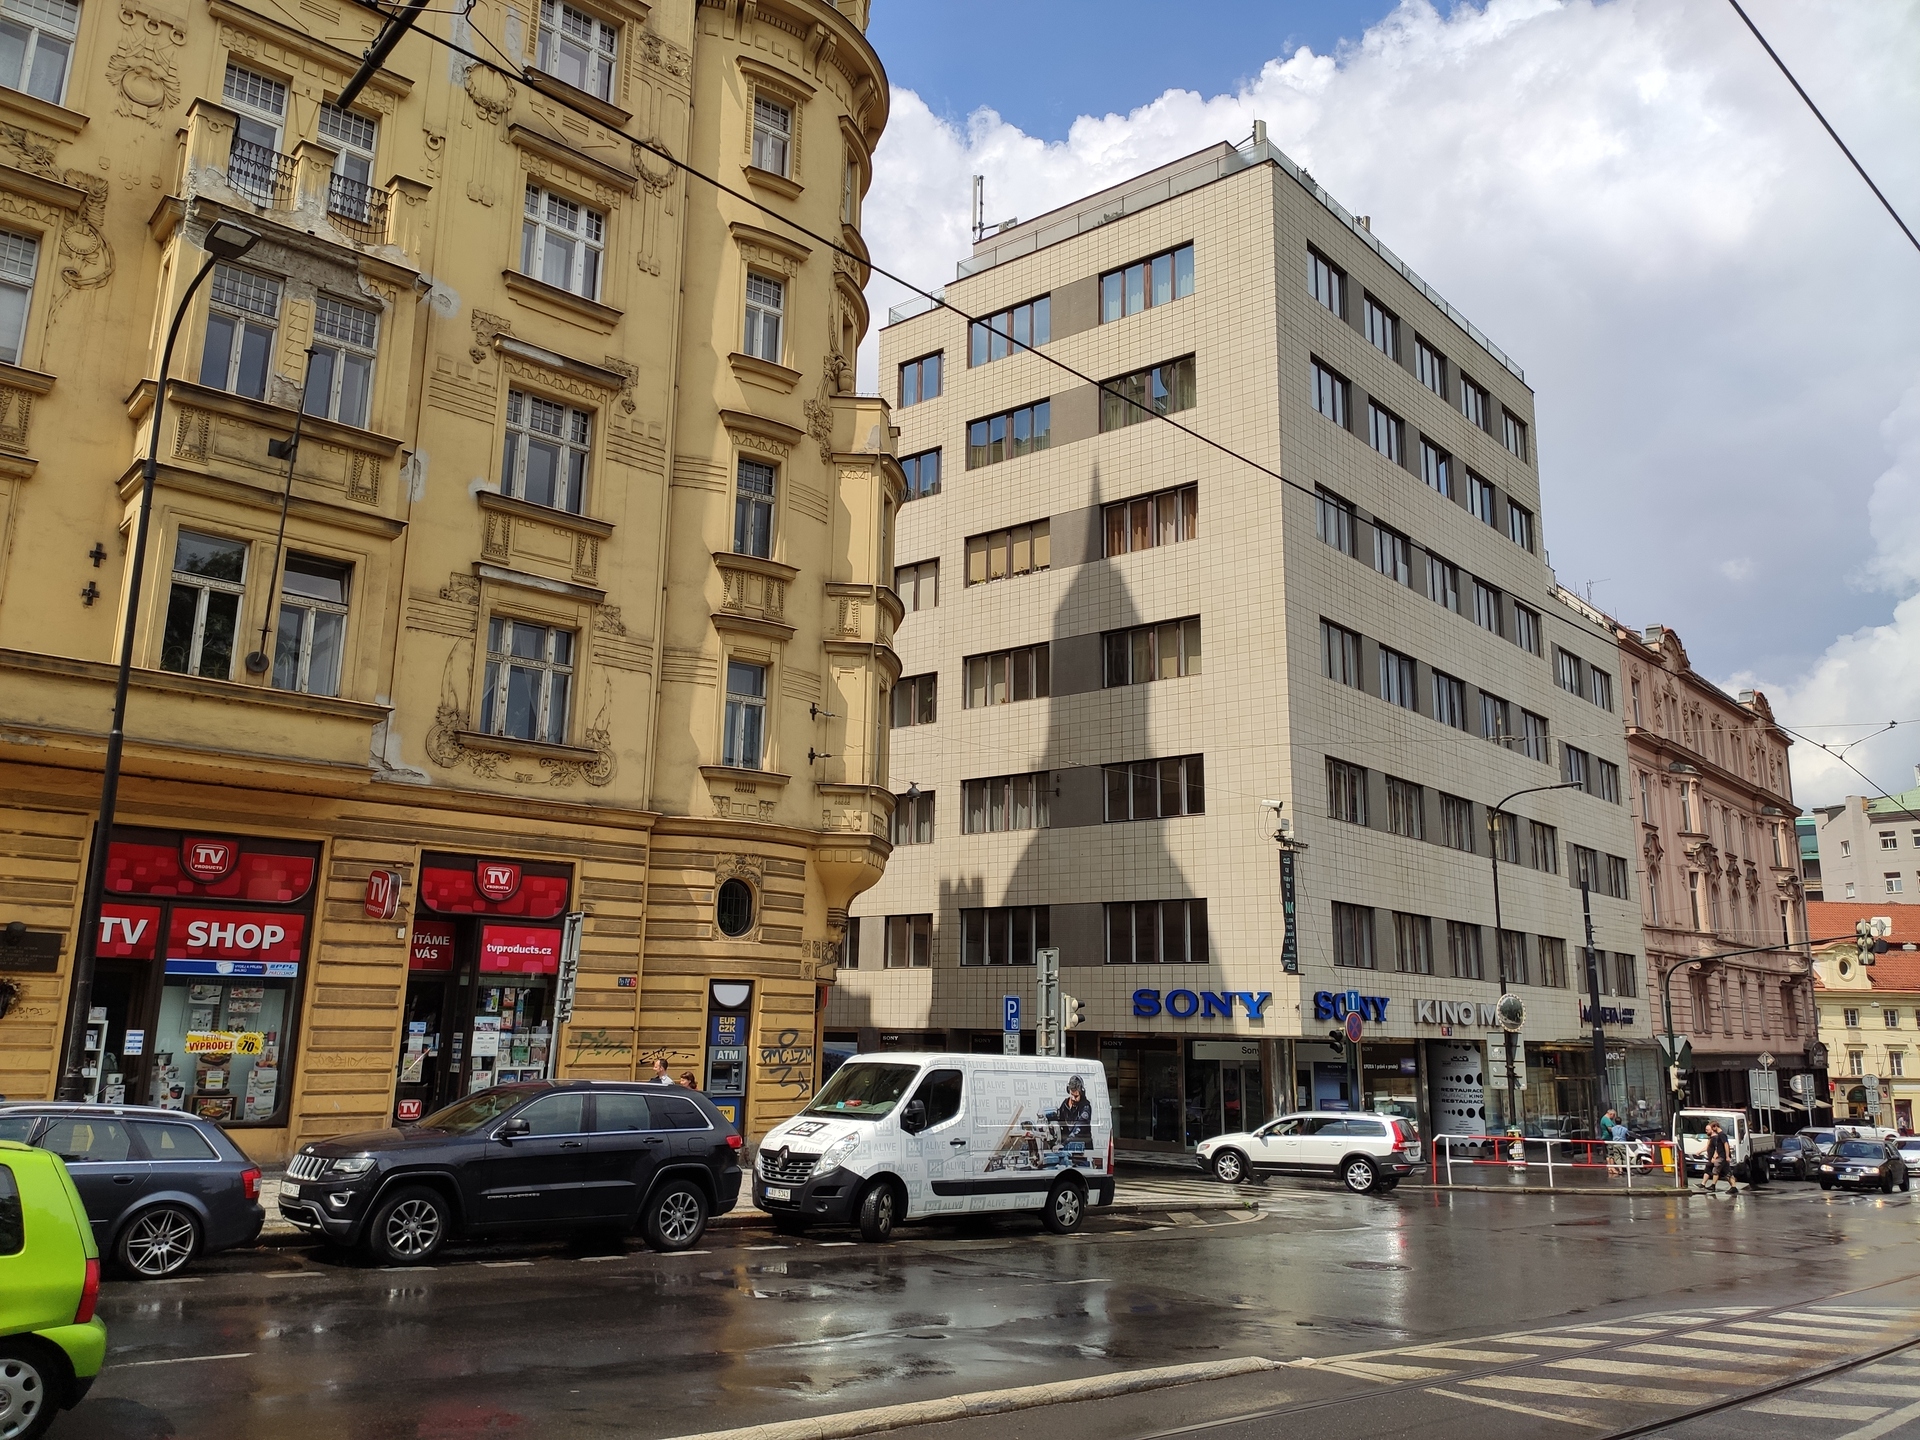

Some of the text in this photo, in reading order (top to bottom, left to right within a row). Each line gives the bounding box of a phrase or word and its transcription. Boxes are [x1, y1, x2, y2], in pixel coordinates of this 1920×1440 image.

[195, 848, 225, 864] TV
[487, 871, 510, 885] TV
[371, 876, 388, 903] TV
[366, 904, 384, 915] PRODUCTS
[100, 916, 149, 945] TV
[187, 920, 285, 950] SHOP
[415, 947, 438, 959] VÁS
[486, 943, 552, 955] tvproducts.cz
[1132, 988, 1272, 1019] SONY
[1314, 990, 1390, 1022] SONY
[1007, 1000, 1017, 1021] P
[1415, 999, 1476, 1026] KINO
[719, 1017, 736, 1025] EUR
[718, 1025, 736, 1033] CZK
[189, 1041, 233, 1051] VÝPRODEJ
[242, 1040, 255, 1052] 70
[717, 1050, 739, 1060] ATM
[968, 1061, 987, 1069] ALIVE
[1010, 1062, 1028, 1070] ALIVE
[1052, 1064, 1069, 1072] ALIVE
[987, 1081, 1006, 1090] ALIVE
[1030, 1082, 1048, 1091] ALIVE
[401, 1102, 420, 1113] TV
[971, 1099, 990, 1108] ALIVE
[874, 1142, 897, 1152] ALIVE
[925, 1141, 946, 1150] ALIVE
[972, 1140, 992, 1149] ALIVE
[896, 1163, 919, 1173] ALIVE
[945, 1161, 966, 1171] ALIVE
[942, 1201, 964, 1210] ALIVE
[986, 1199, 1007, 1208] ALIVE
[1030, 1197, 1045, 1206] ALIV
